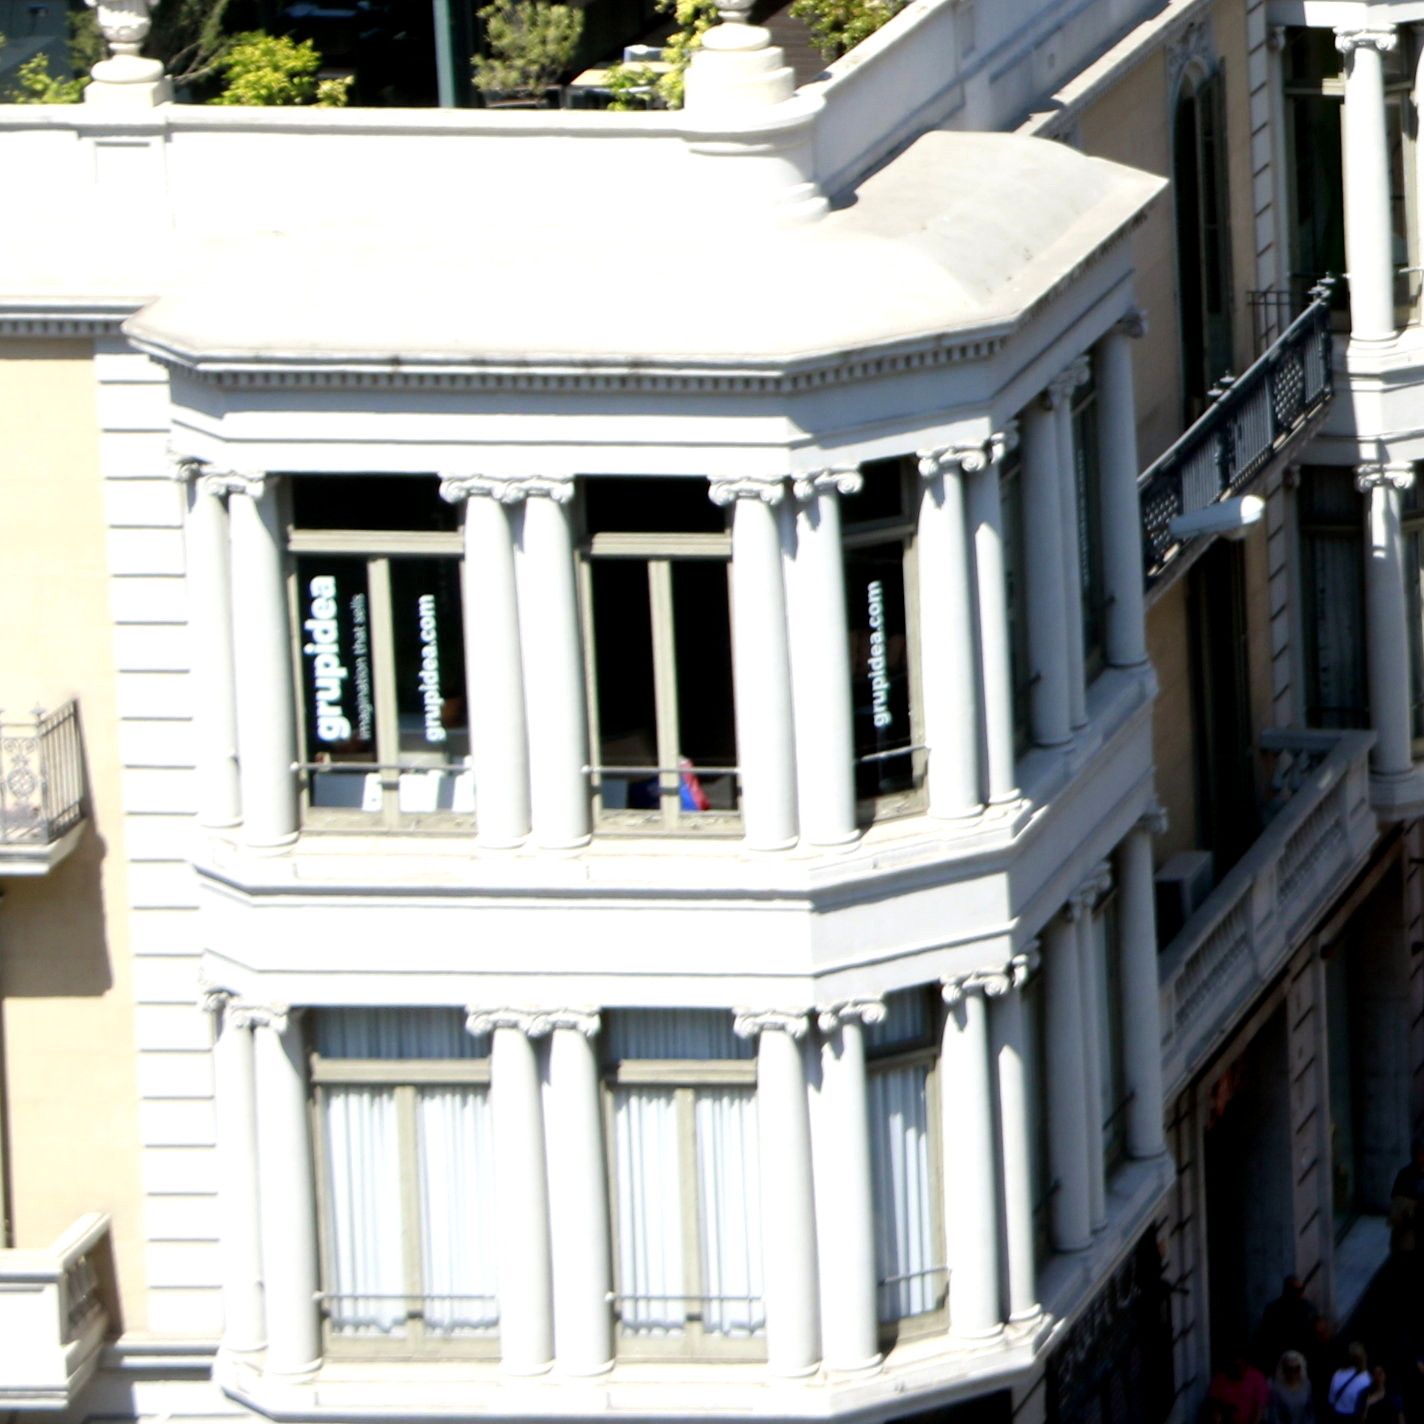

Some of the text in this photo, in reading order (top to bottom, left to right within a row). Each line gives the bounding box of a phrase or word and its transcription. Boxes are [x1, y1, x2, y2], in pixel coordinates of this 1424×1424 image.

[304, 575, 351, 741] grupidea
[350, 593, 372, 741] imagination that sells
[418, 594, 447, 742] grupidea.com
[867, 580, 893, 727] grupidea.com
